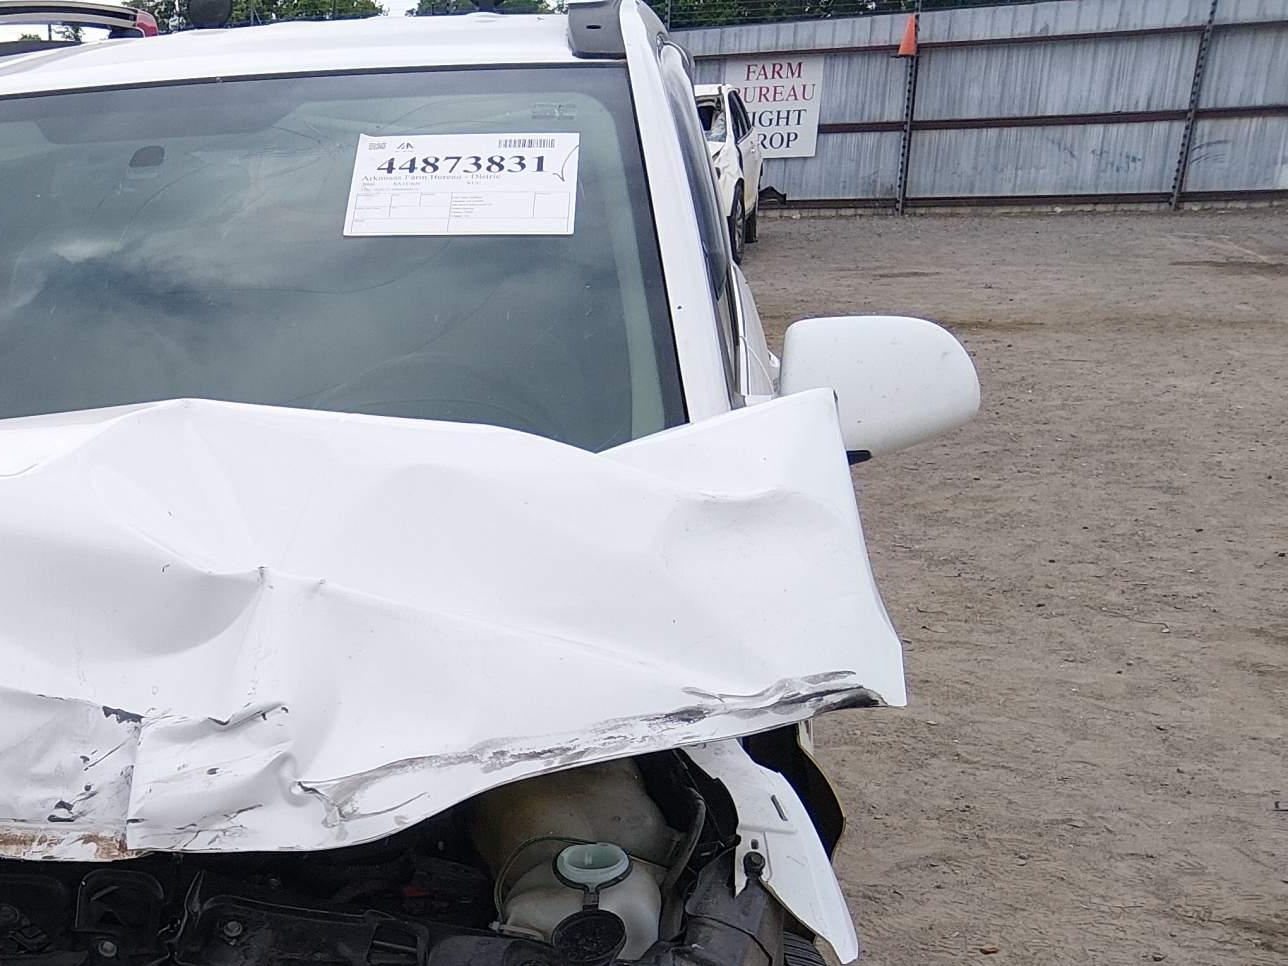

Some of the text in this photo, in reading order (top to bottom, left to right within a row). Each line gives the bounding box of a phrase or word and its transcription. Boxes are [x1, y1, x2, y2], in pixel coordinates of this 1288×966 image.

[744, 62, 803, 81] FARM
[747, 109, 807, 128] IGHT
[757, 132, 799, 149] ROP
[376, 155, 545, 174] 44873831
